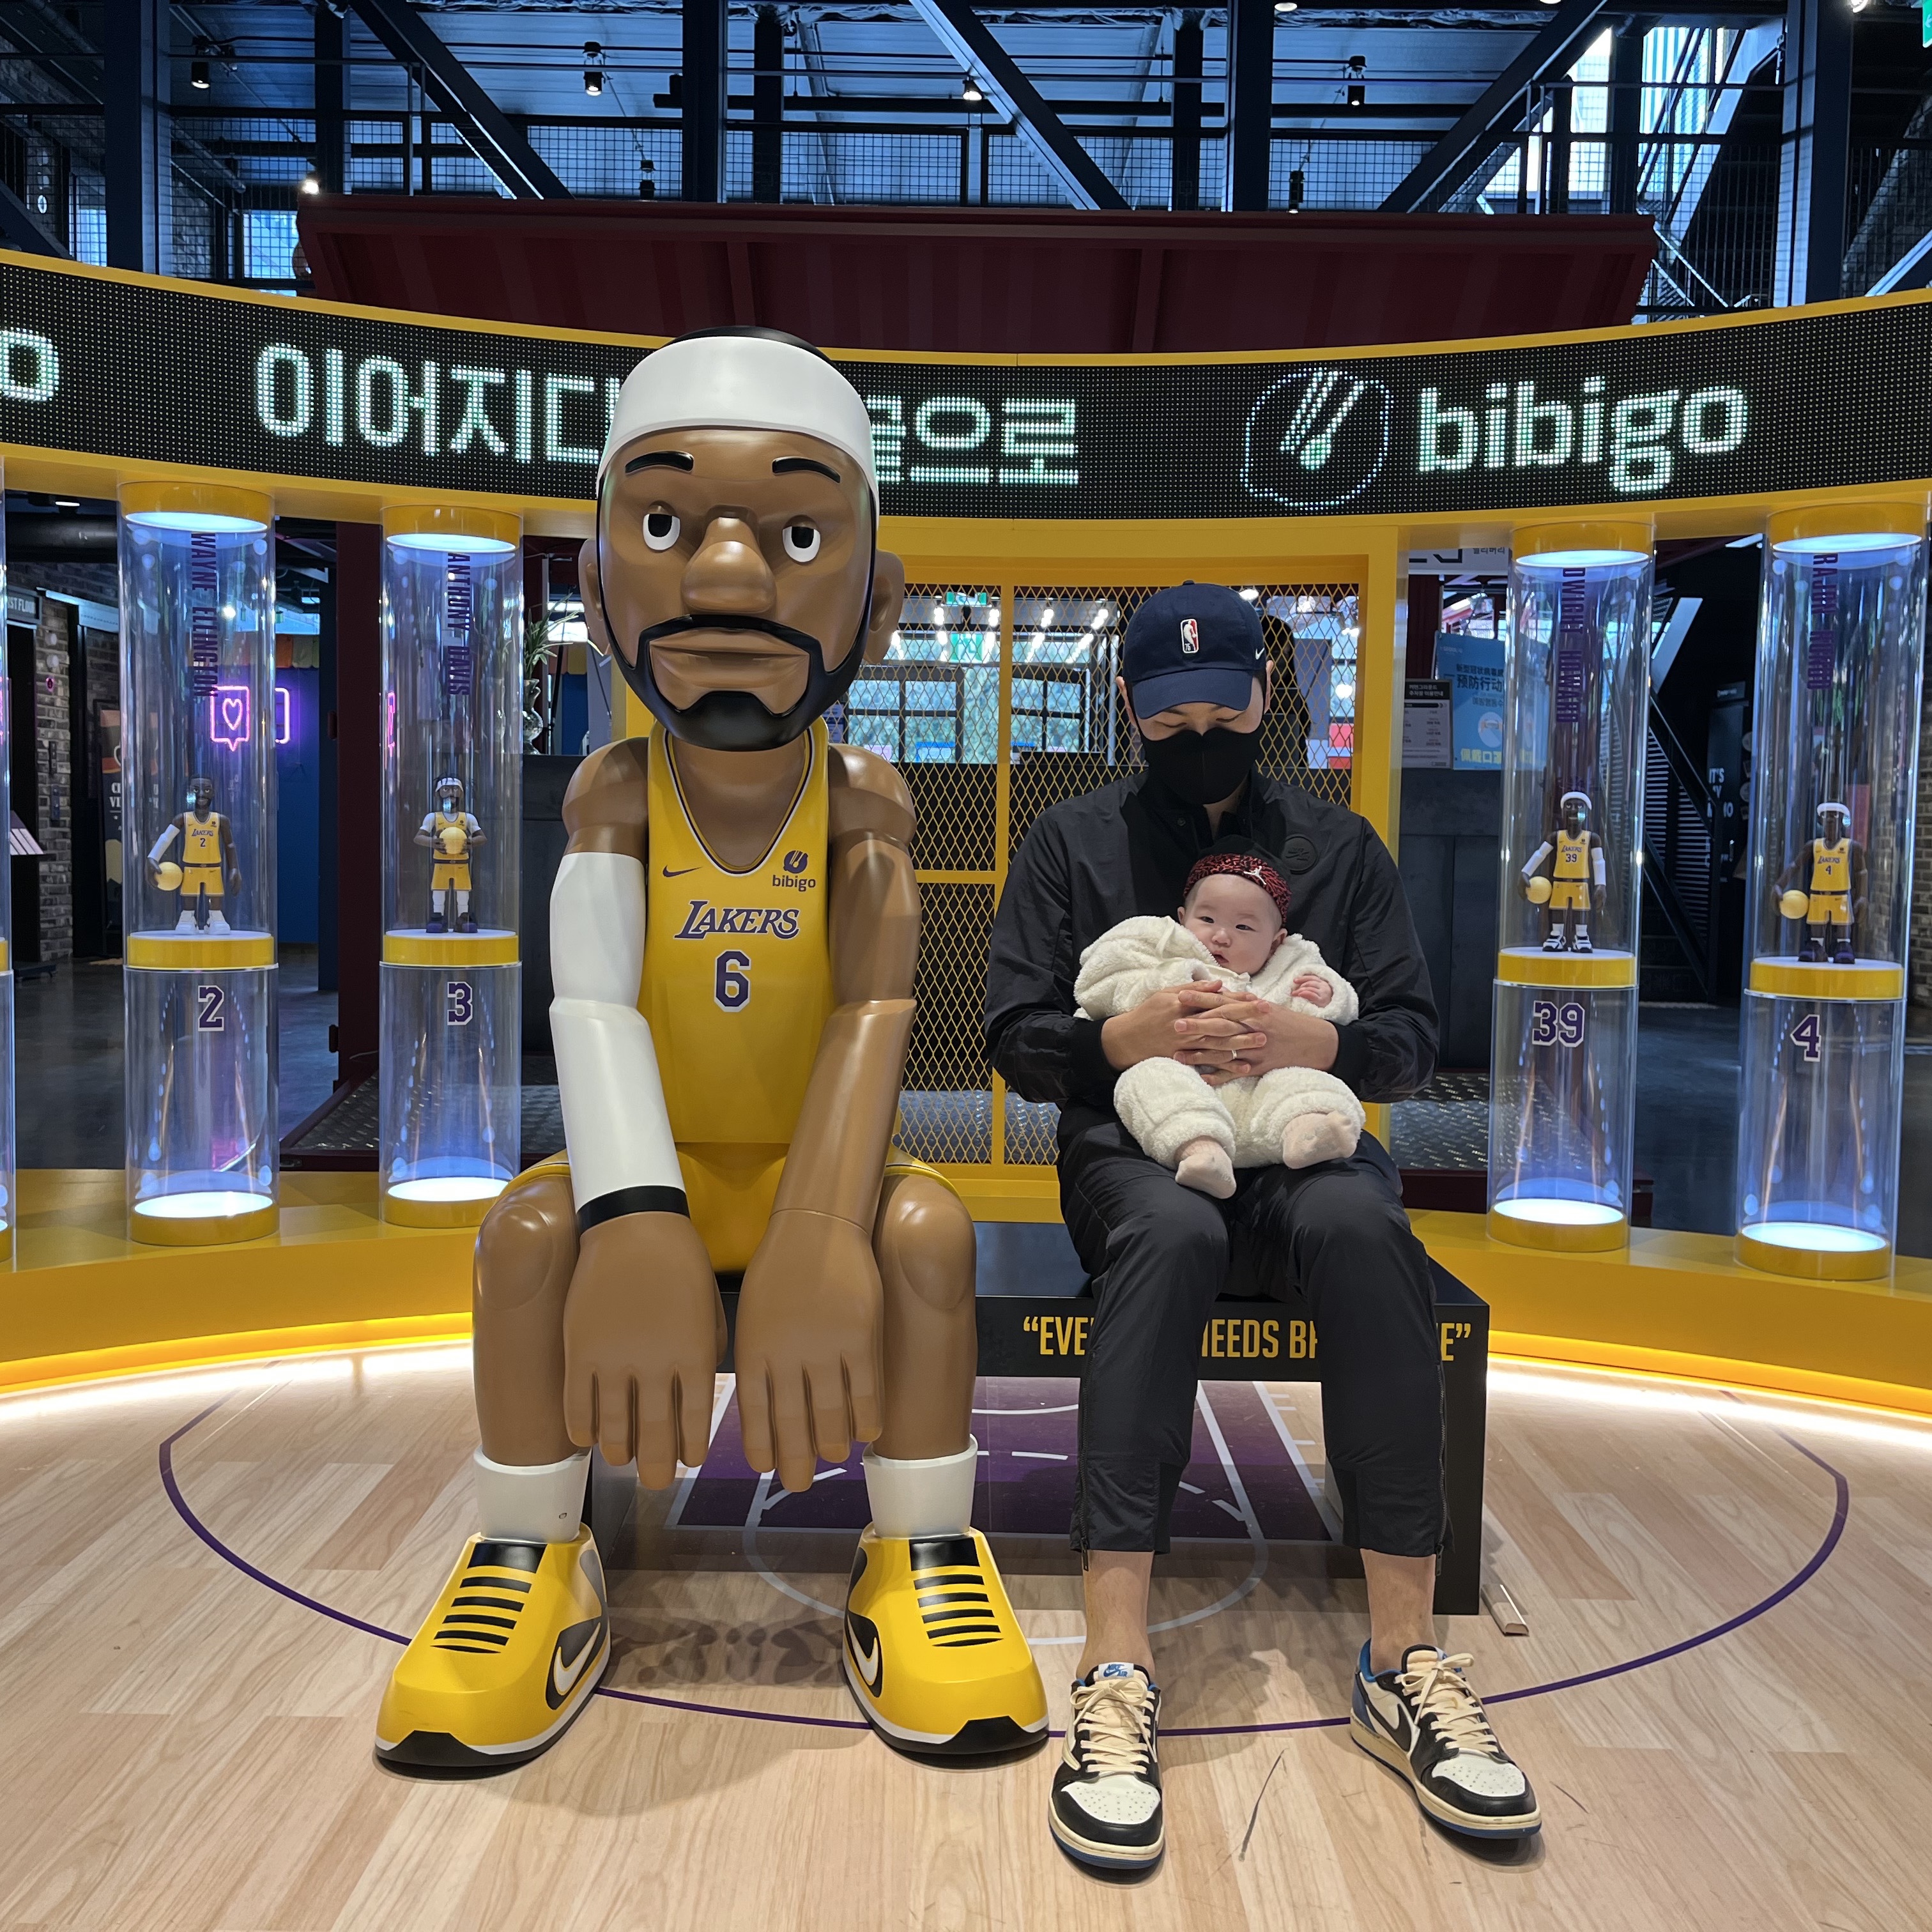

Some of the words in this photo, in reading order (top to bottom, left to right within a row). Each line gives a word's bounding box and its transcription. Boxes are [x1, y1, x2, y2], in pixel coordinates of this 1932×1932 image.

[1418, 376, 1749, 493] bibigo
[191, 533, 217, 591] WAYNE
[447, 553, 470, 631] ANTHONY
[1560, 567, 1586, 634] DWIGHT
[192, 608, 218, 697] ELLINGTON
[447, 646, 470, 695] DAVIS
[200, 838, 206, 848] 2
[1565, 853, 1577, 862] 39
[772, 875, 816, 891] bibigo
[1825, 865, 1832, 875] 4
[673, 900, 800, 940] LAKERS
[447, 982, 473, 1025] 3
[714, 949, 751, 1013] 6
[198, 985, 224, 1031] 2
[1533, 1000, 1585, 1047] 39
[1790, 1015, 1821, 1062] 4
